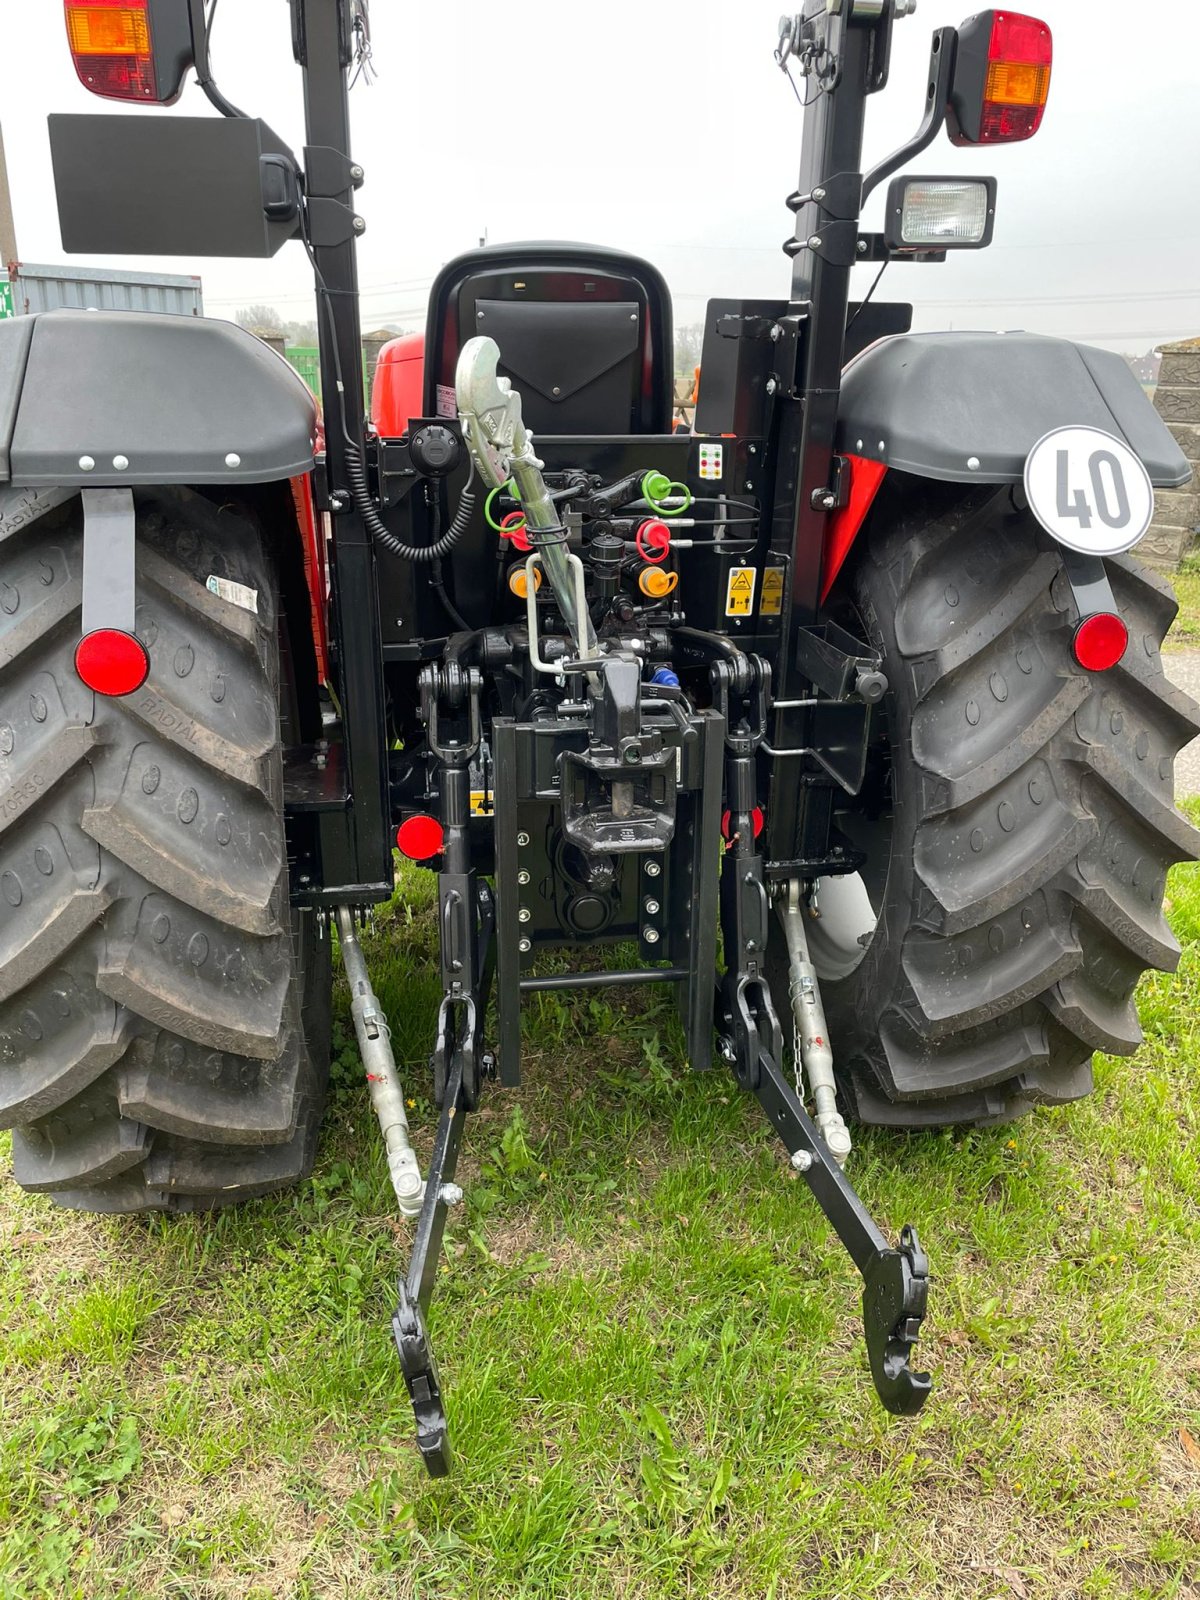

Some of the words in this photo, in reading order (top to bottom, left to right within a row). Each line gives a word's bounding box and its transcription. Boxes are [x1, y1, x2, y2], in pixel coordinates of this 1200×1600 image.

[1056, 449, 1131, 529] 40
[0, 502, 50, 533] ADIAL
[140, 698, 197, 745] RADIAL
